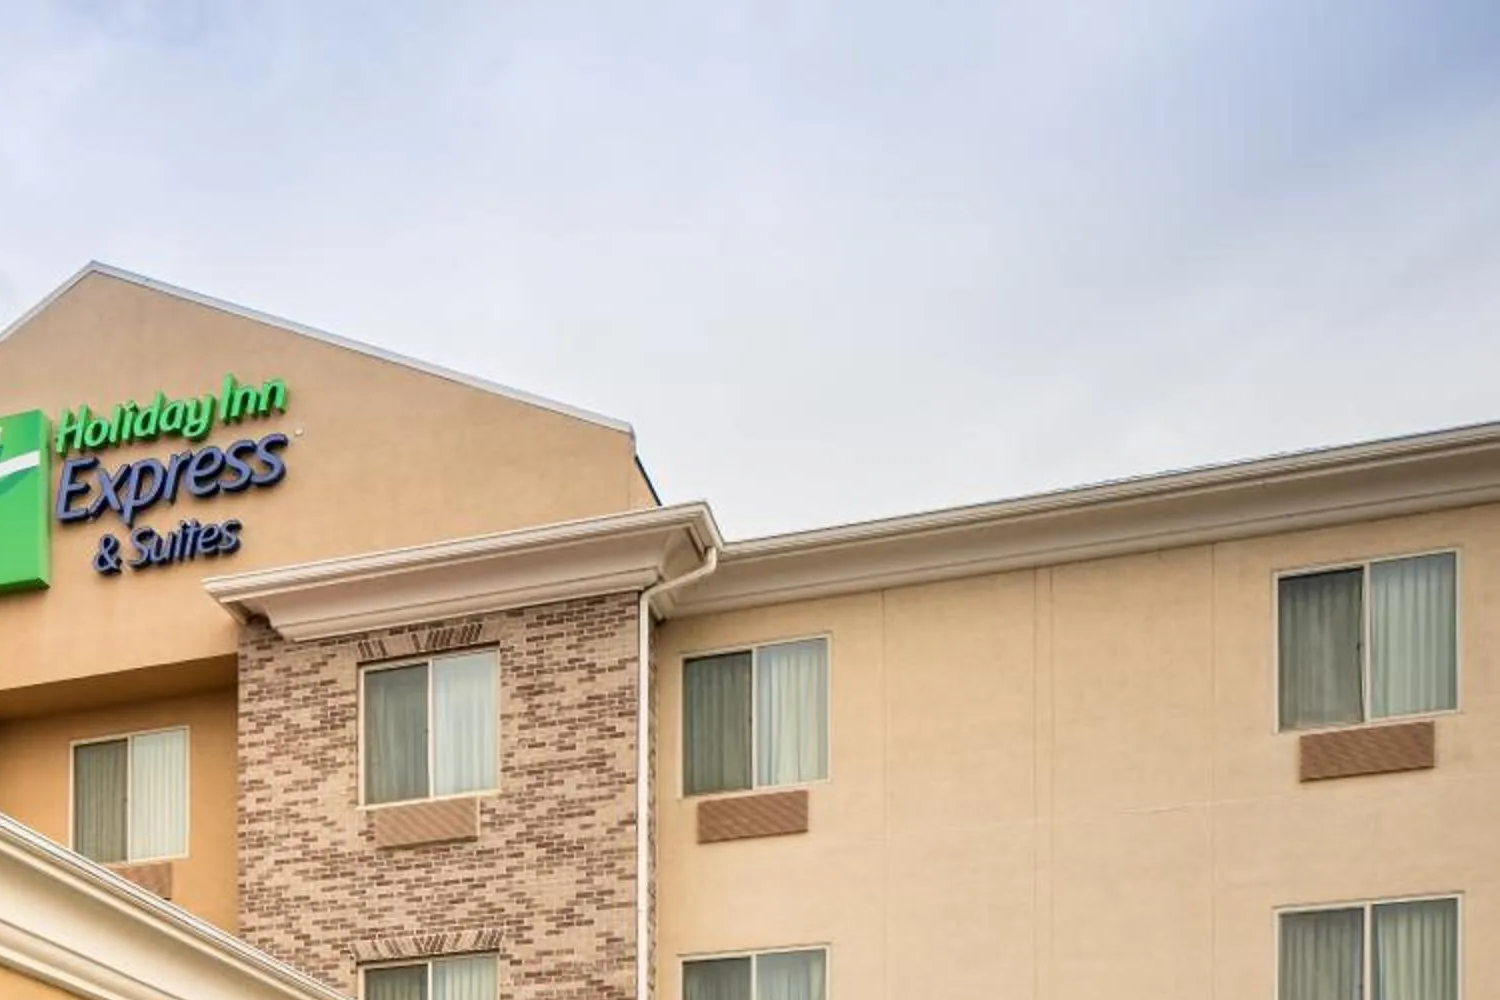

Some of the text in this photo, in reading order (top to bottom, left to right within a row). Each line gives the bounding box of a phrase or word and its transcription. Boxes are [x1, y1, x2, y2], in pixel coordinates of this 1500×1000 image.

[55, 372, 289, 456] Holiday Inn
[56, 433, 289, 528] Express
[93, 518, 243, 575] & Suites
